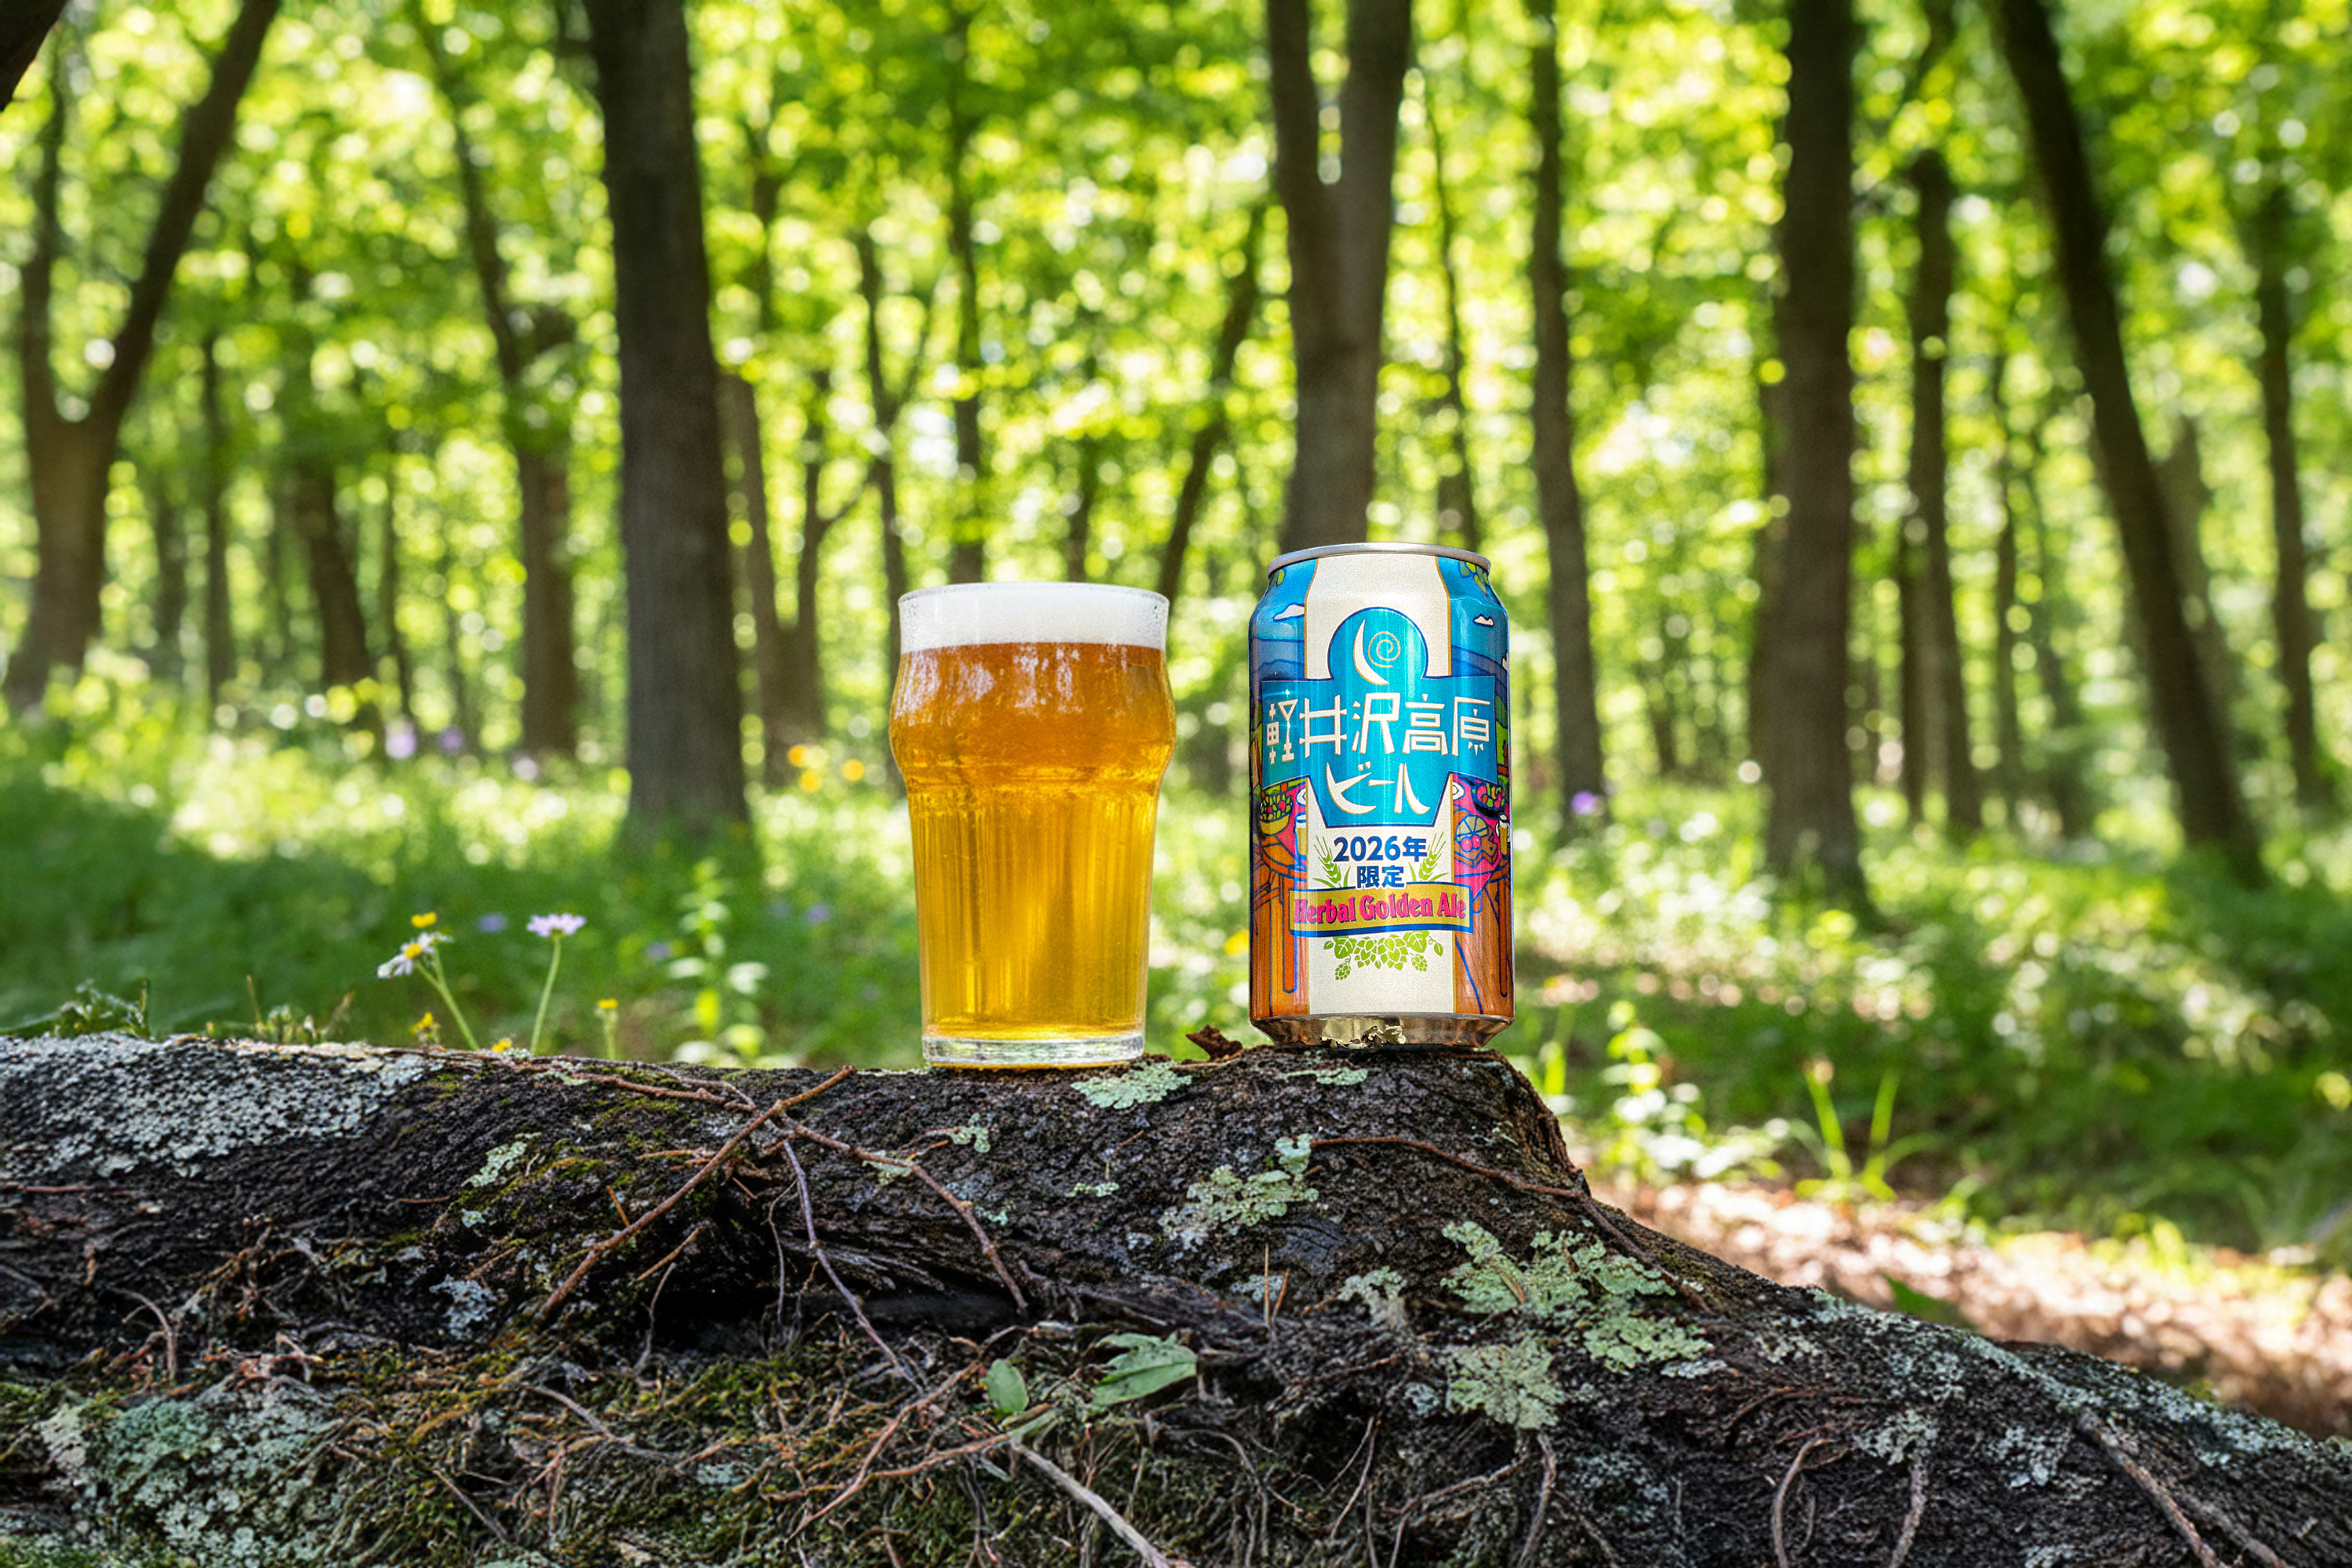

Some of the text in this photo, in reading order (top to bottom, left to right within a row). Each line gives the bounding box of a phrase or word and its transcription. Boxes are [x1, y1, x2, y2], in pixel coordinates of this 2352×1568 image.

[1266, 692, 1490, 764] 軽井沢高原
[1326, 760, 1431, 815] ビール
[1333, 836, 1428, 862] 2026年
[1356, 866, 1406, 889] 限定
[1294, 891, 1466, 924] Herbal Golden Ale
